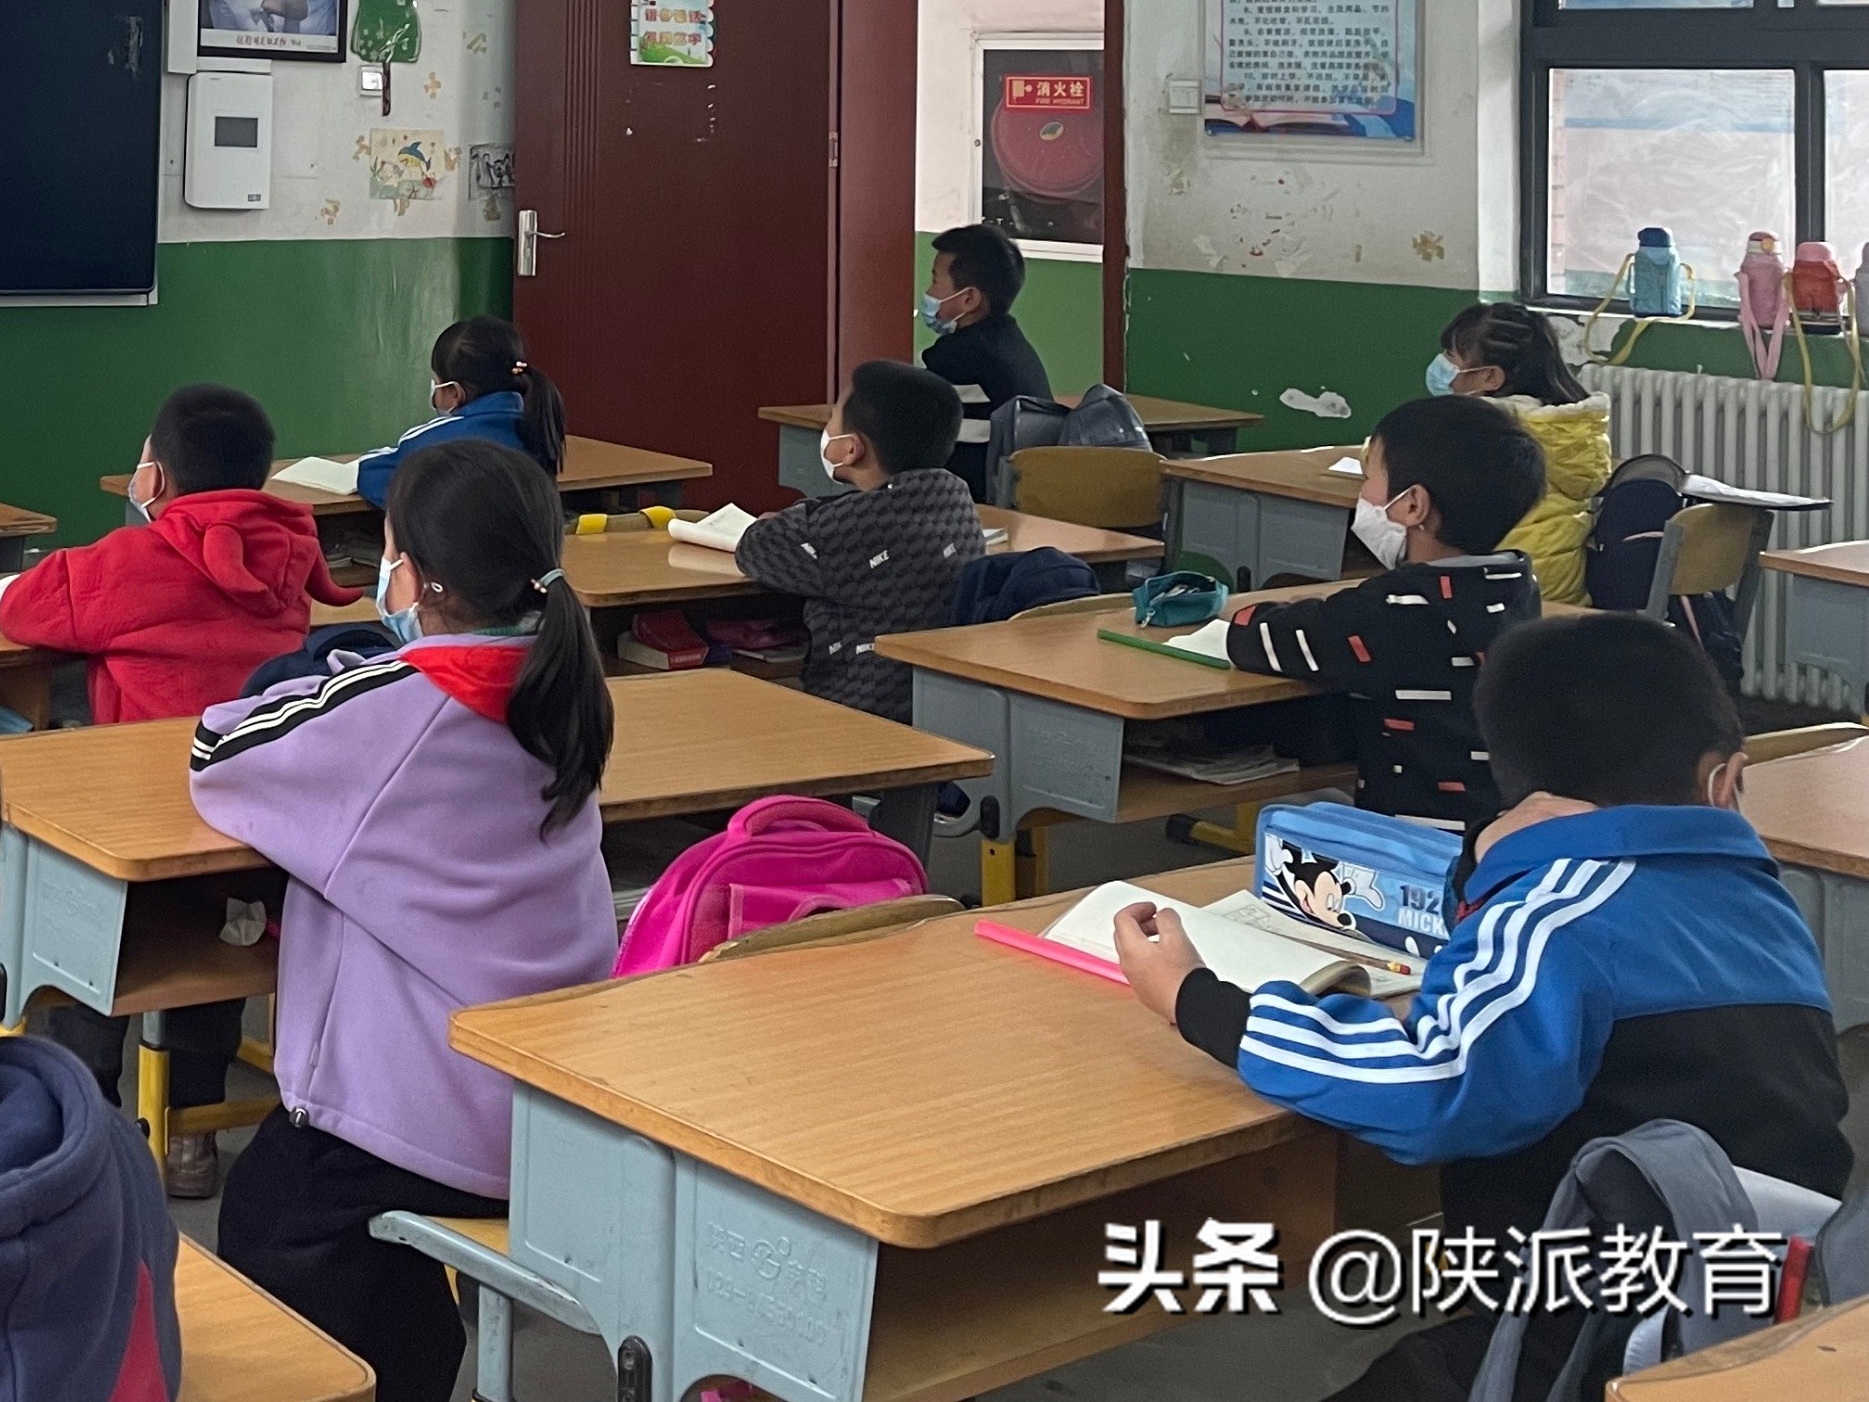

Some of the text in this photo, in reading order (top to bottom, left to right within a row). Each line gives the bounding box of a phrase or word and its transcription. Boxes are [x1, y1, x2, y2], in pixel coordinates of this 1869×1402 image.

[1036, 80, 1085, 97] 消火栓
[869, 549, 890, 570] NIKE
